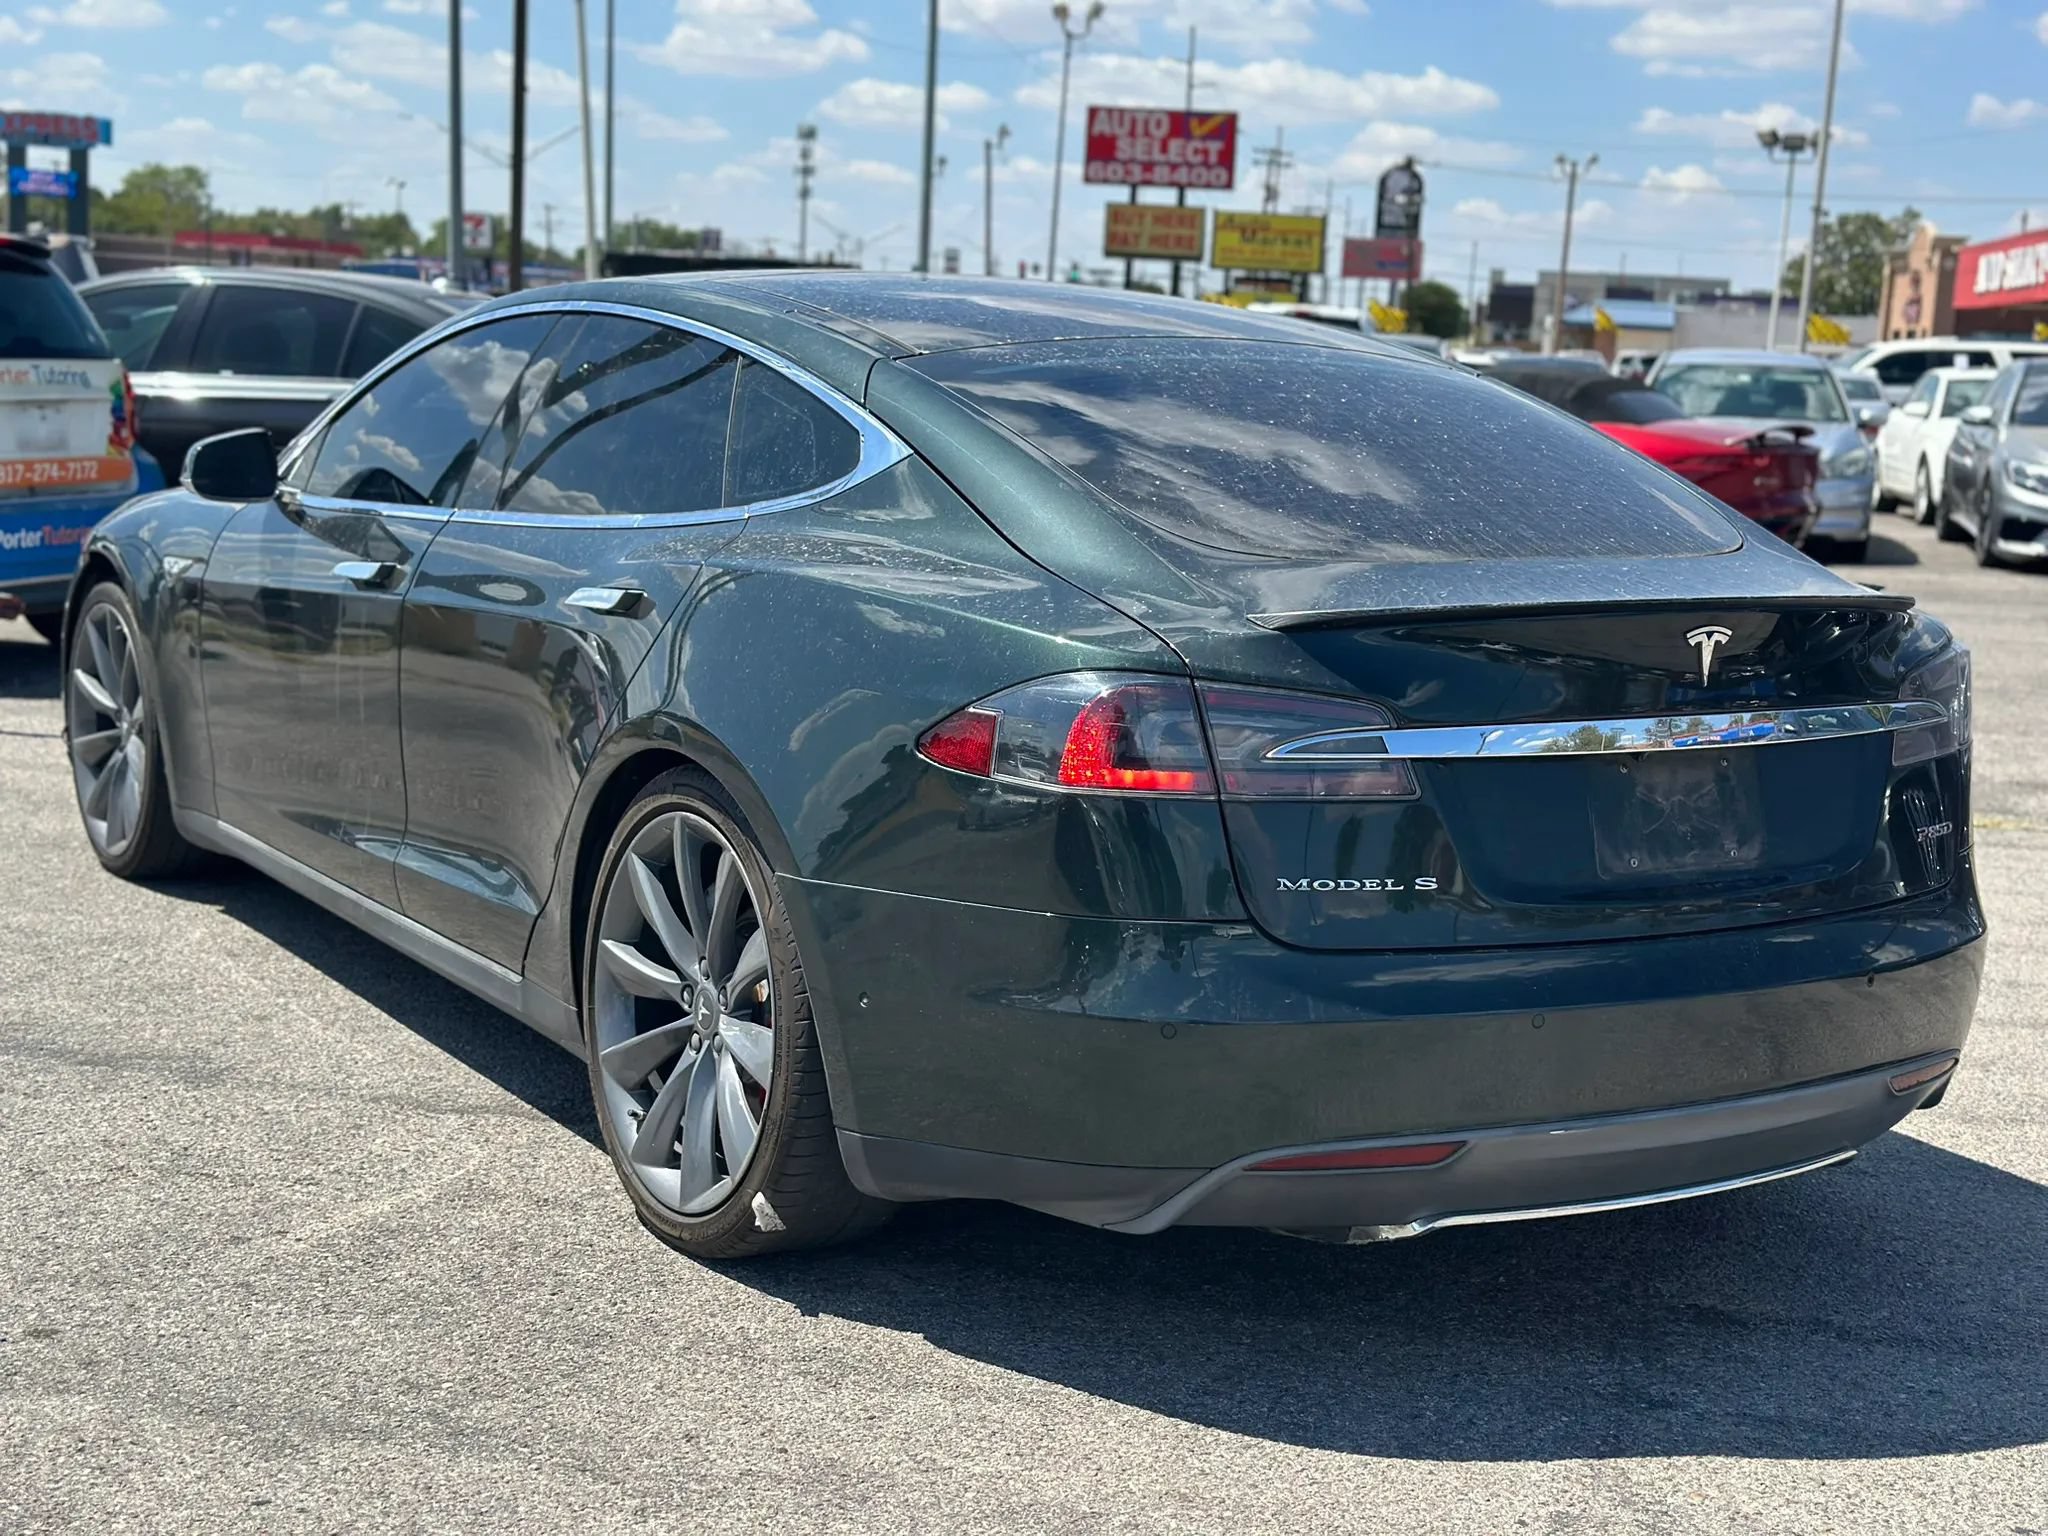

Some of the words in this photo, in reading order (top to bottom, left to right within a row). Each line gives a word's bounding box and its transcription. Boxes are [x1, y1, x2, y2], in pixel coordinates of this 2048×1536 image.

[1092, 109, 1170, 140] AUTO
[1115, 136, 1225, 165] SELECT
[1087, 160, 1230, 187] 603-8400
[1917, 821, 1953, 841] P85D
[1276, 878, 1404, 891] MODEL
[1414, 877, 1439, 890] S
